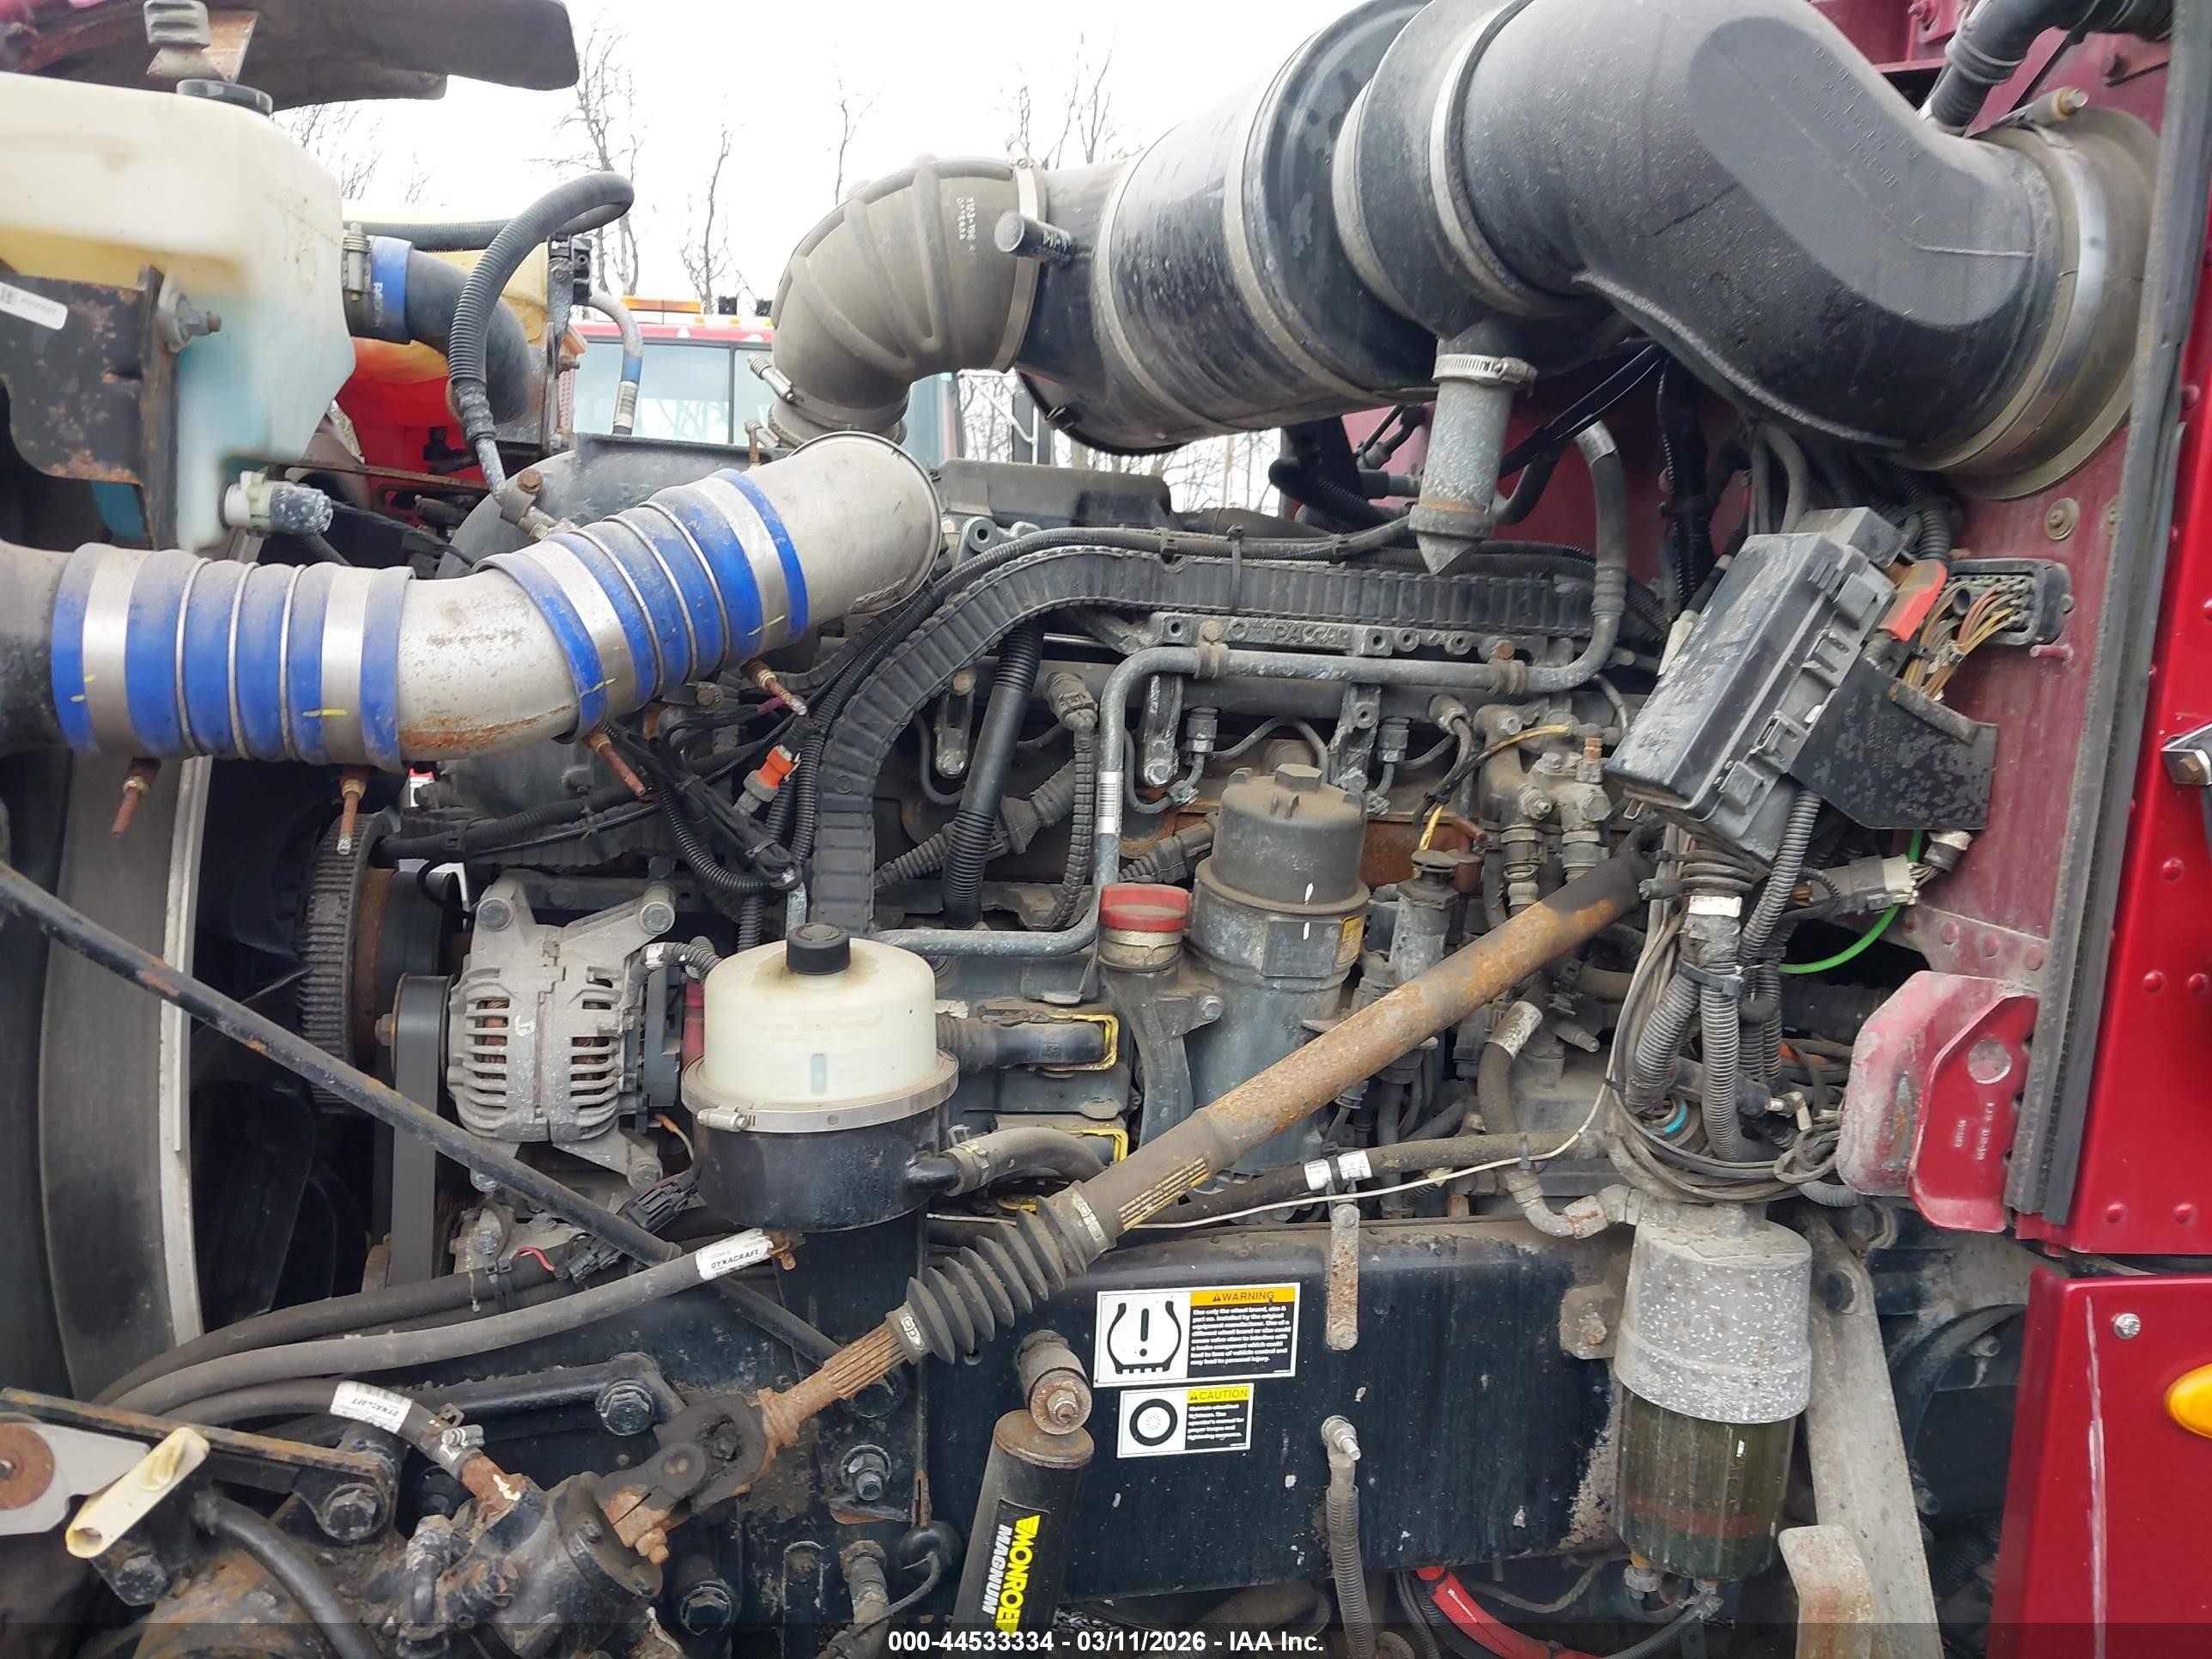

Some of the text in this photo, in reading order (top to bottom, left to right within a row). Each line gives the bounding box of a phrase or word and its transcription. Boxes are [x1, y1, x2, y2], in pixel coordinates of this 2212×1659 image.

[711, 1249, 759, 1269] DYNACRAFT
[1223, 1291, 1274, 1302] WARNING
[1199, 1389, 1248, 1400] CAUTION
[981, 1523, 1013, 1615] MAGNUM
[995, 1524, 1037, 1623] MONROE
